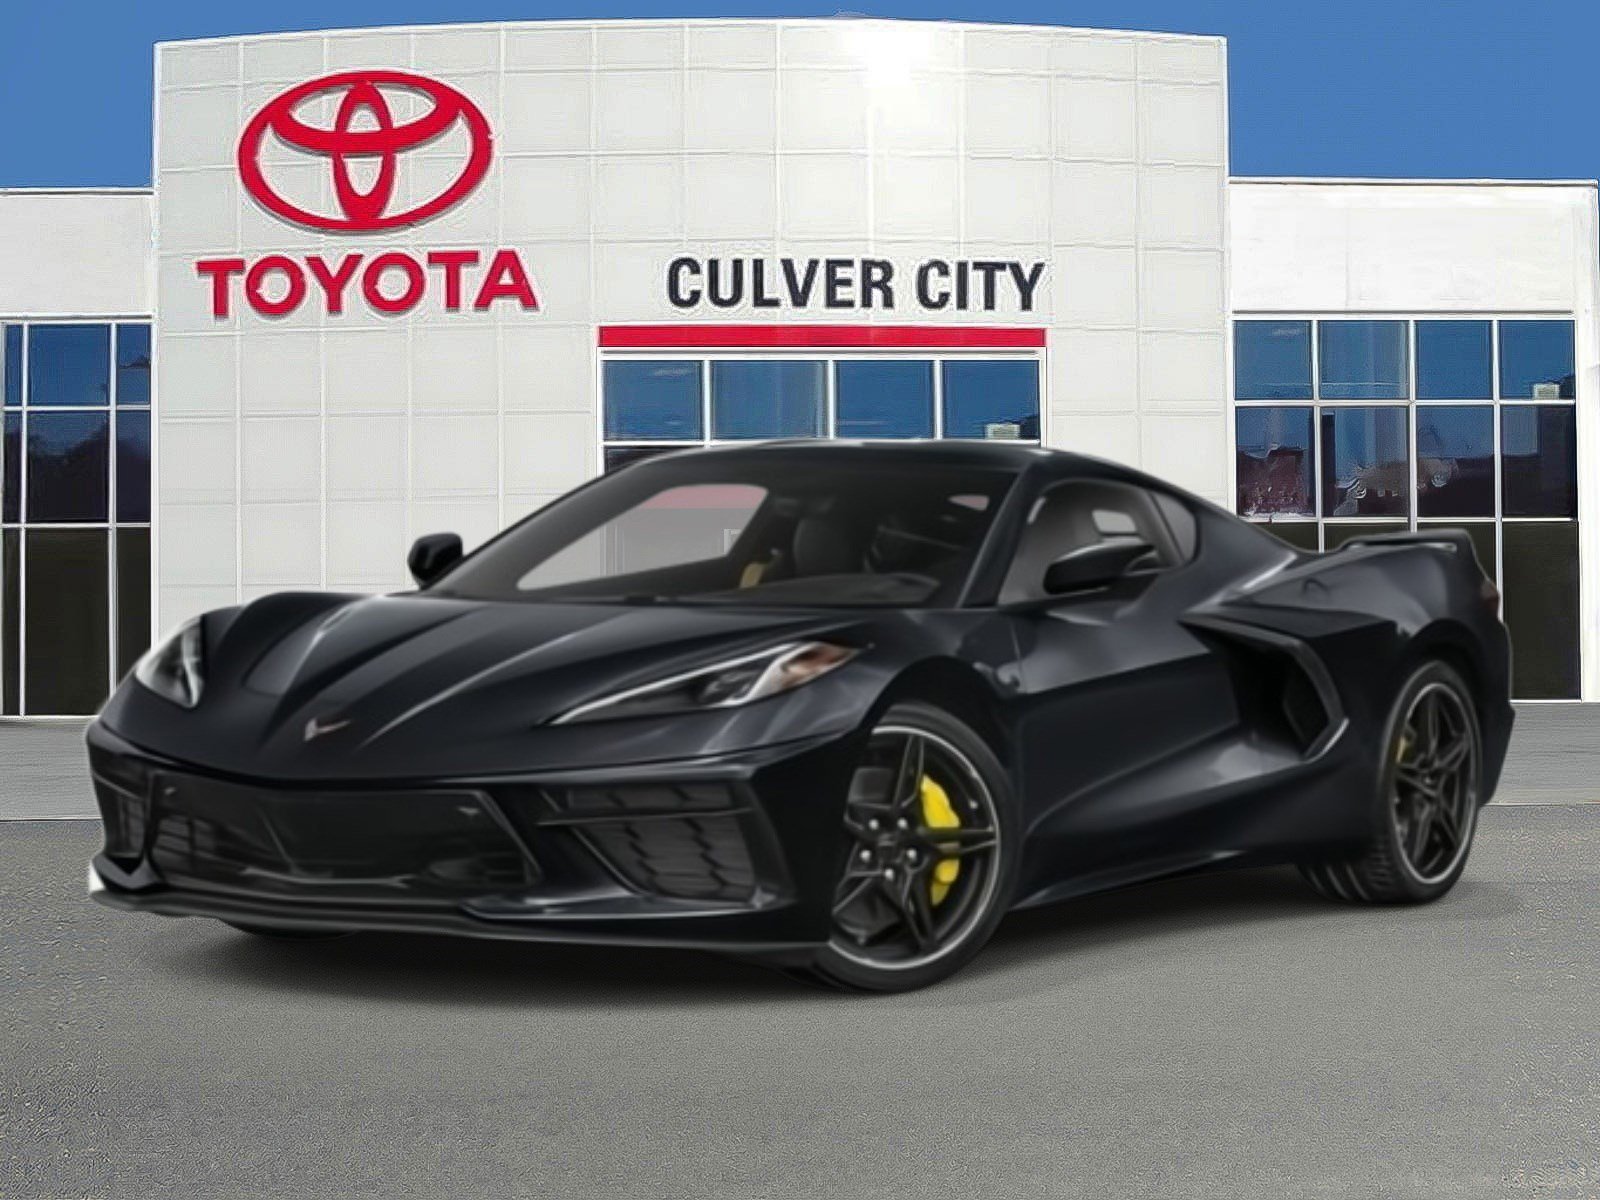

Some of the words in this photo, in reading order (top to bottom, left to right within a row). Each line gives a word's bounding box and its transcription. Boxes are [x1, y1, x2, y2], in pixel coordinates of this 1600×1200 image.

[196, 250, 538, 317] TOYOTA
[668, 256, 894, 309] CULVER
[916, 259, 1046, 311] CITY
